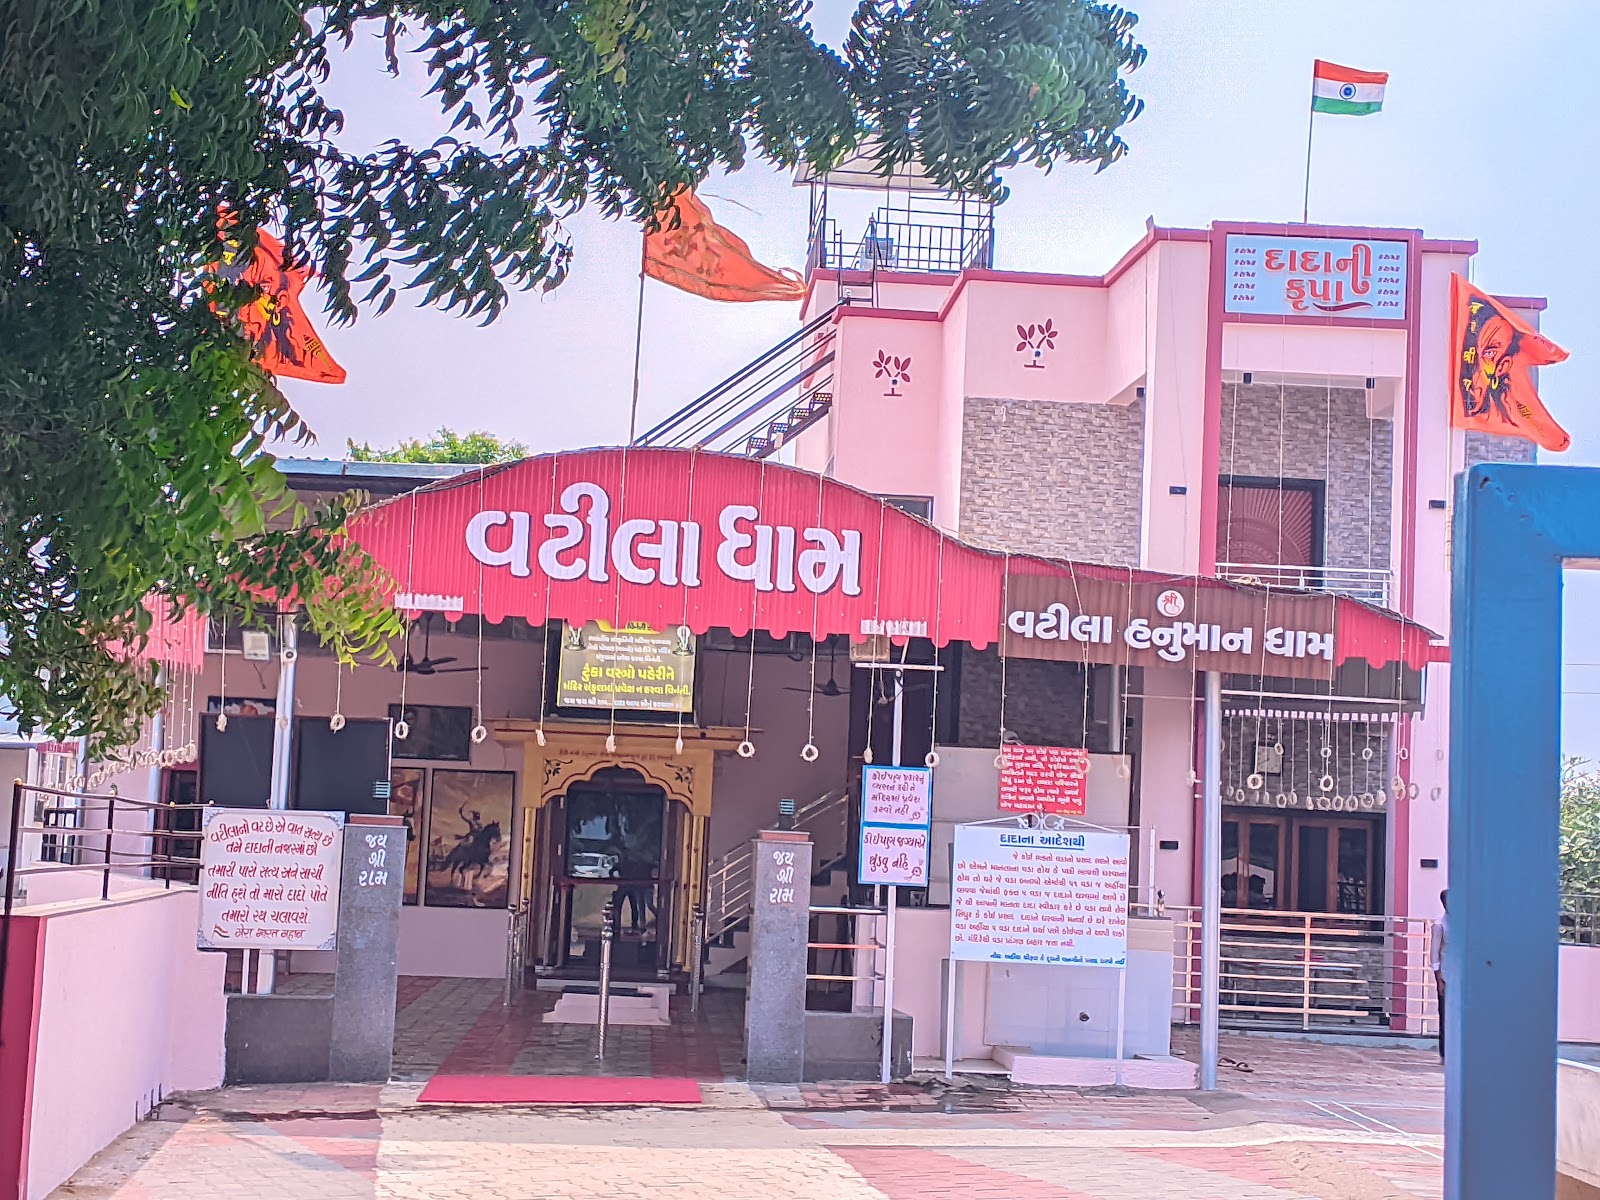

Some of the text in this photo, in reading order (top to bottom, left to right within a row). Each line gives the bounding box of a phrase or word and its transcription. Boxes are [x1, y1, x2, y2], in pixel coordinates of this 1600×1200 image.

[1264, 244, 1372, 295] દાદાની
[1285, 279, 1344, 311] કૃપા
[466, 481, 863, 596] વટીલા ધામ
[1008, 602, 1335, 662] વટીલા હનુમાન ધામ
[638, 665, 675, 681] પહેરીને
[211, 819, 249, 843] વટીલાનો
[288, 822, 303, 835] વાત
[245, 839, 274, 854] દાદાની
[366, 834, 387, 849] જય
[1000, 833, 1085, 847] દાદાના આદેશથી
[773, 851, 794, 866] જય
[208, 861, 235, 877] તમારી
[300, 864, 324, 880] સાચી
[358, 870, 388, 887] રામ
[207, 883, 229, 899] નીતિ
[250, 884, 260, 901] તો
[287, 885, 306, 902] દાદો
[770, 888, 794, 903] રામ
[221, 906, 250, 923] તમારો
